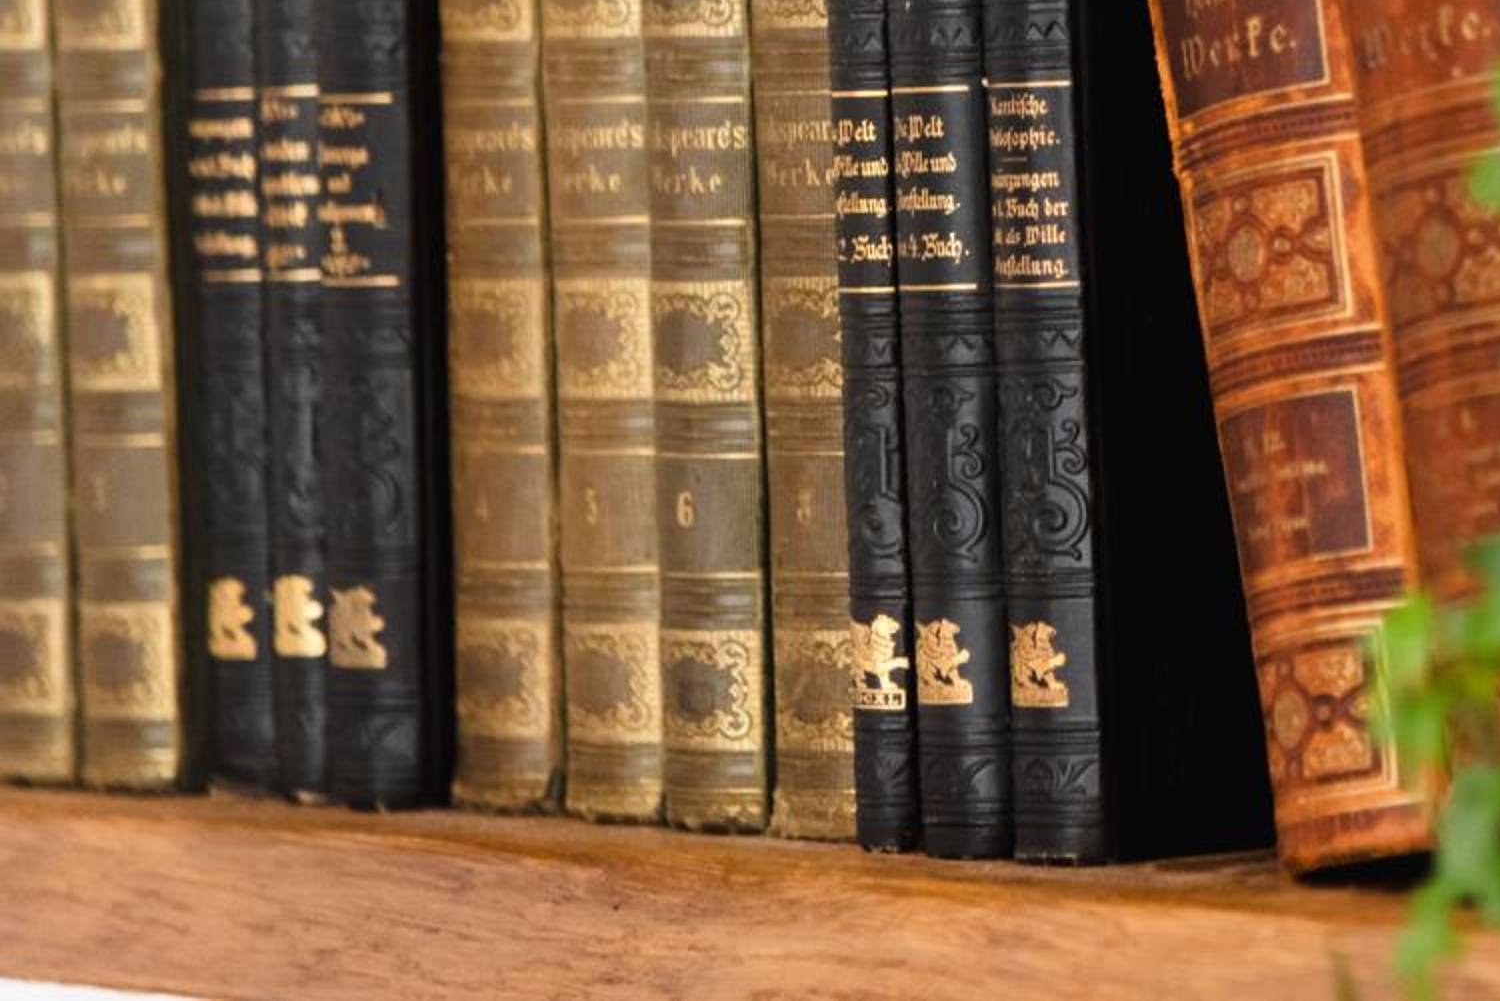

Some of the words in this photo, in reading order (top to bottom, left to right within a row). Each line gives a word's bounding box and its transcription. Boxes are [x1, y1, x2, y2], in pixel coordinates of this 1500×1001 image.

[837, 118, 877, 147] Welt
[908, 114, 945, 143] Welt
[1043, 197, 1070, 217] der
[1024, 223, 1067, 247] Wille
[676, 490, 695, 529] 6
